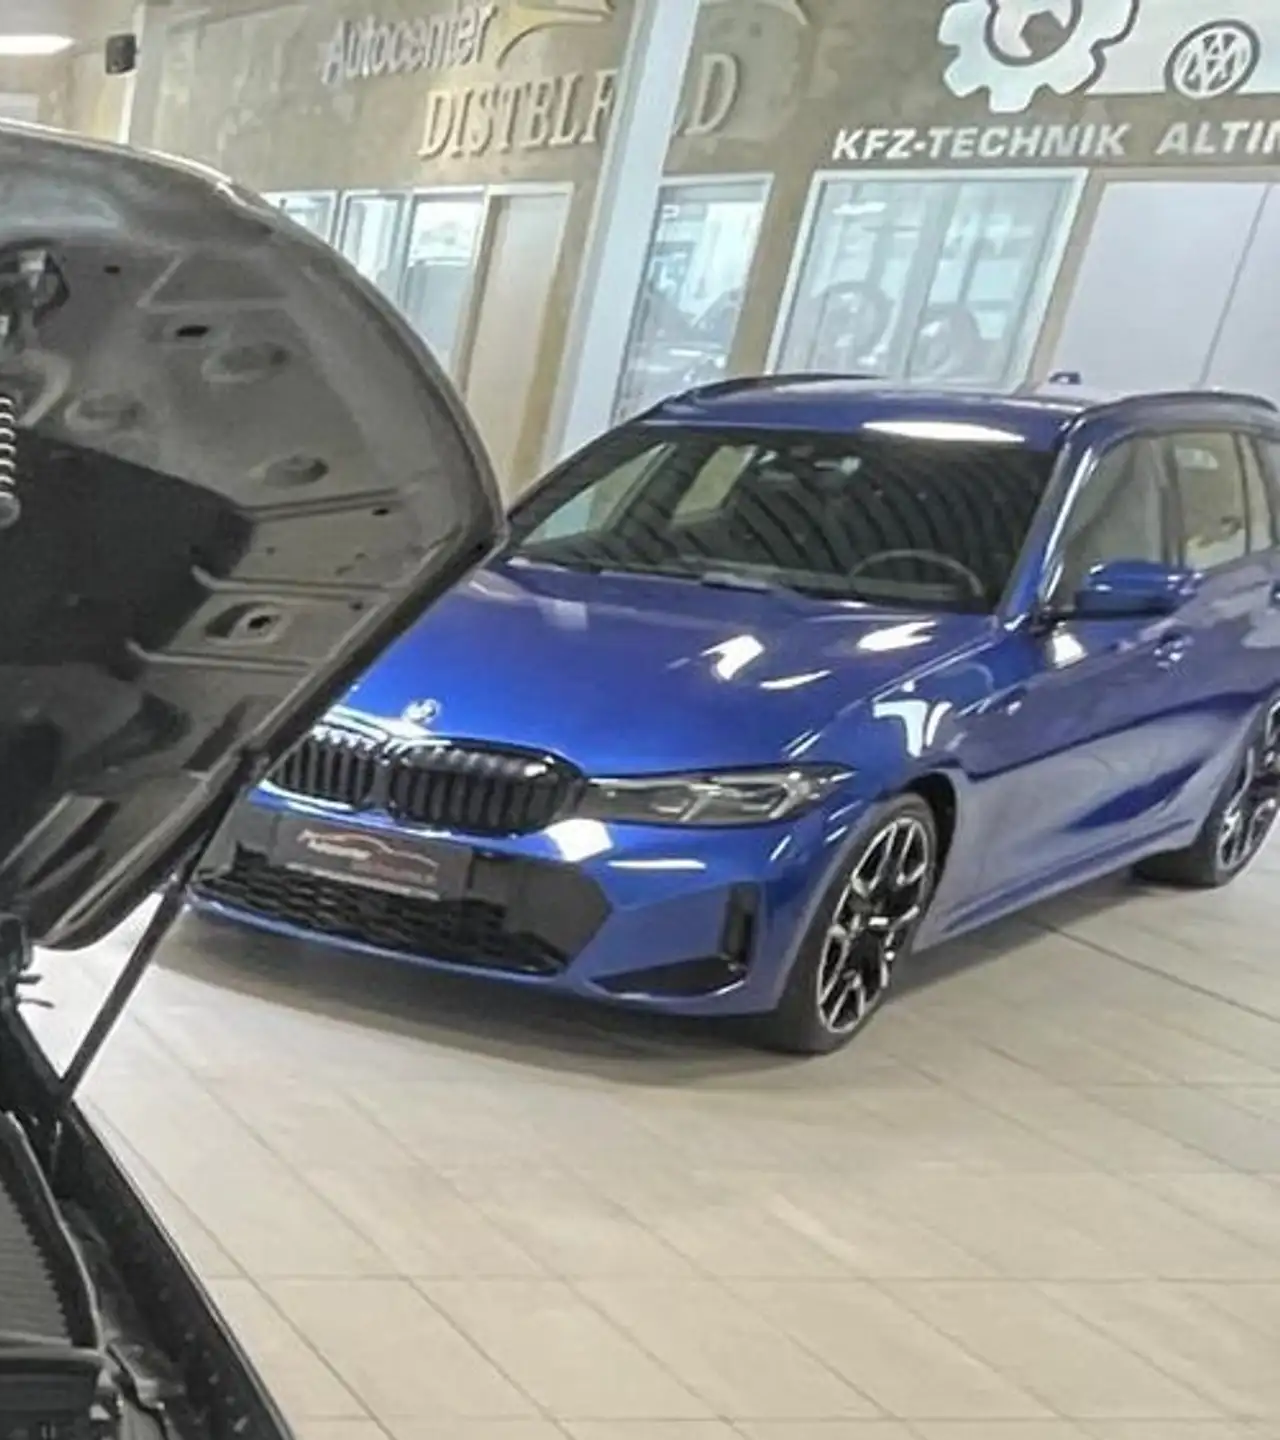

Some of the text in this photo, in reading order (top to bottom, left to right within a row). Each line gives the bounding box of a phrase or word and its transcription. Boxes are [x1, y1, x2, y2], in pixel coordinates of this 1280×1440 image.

[321, 0, 497, 85] Autocenter
[417, 53, 739, 160] DISTELFD
[832, 123, 1132, 161] KFZ-TECHNIK
